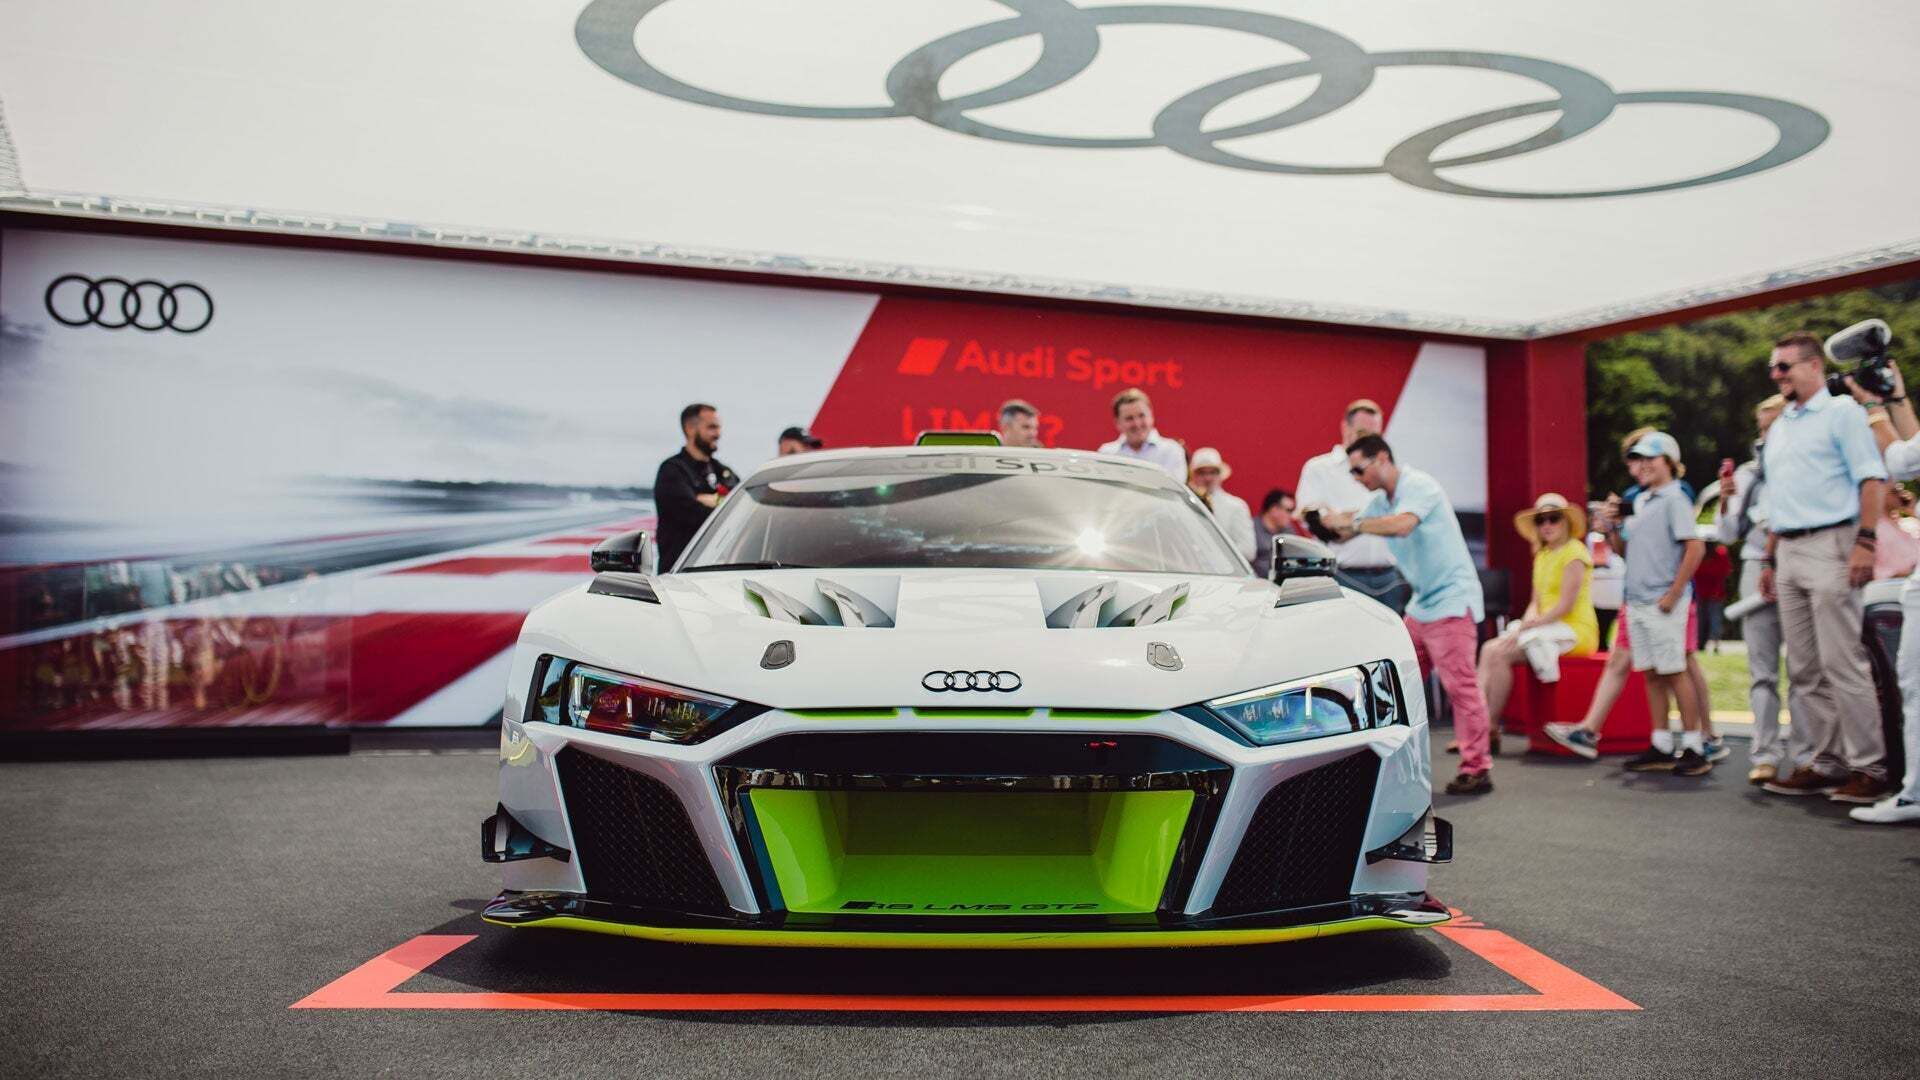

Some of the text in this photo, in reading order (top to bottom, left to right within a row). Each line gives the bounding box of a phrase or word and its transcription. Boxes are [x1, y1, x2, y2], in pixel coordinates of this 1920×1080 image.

[955, 339, 1184, 390] Audi Sport
[902, 406, 1064, 447] LIM?
[870, 457, 1134, 475] udi Spo
